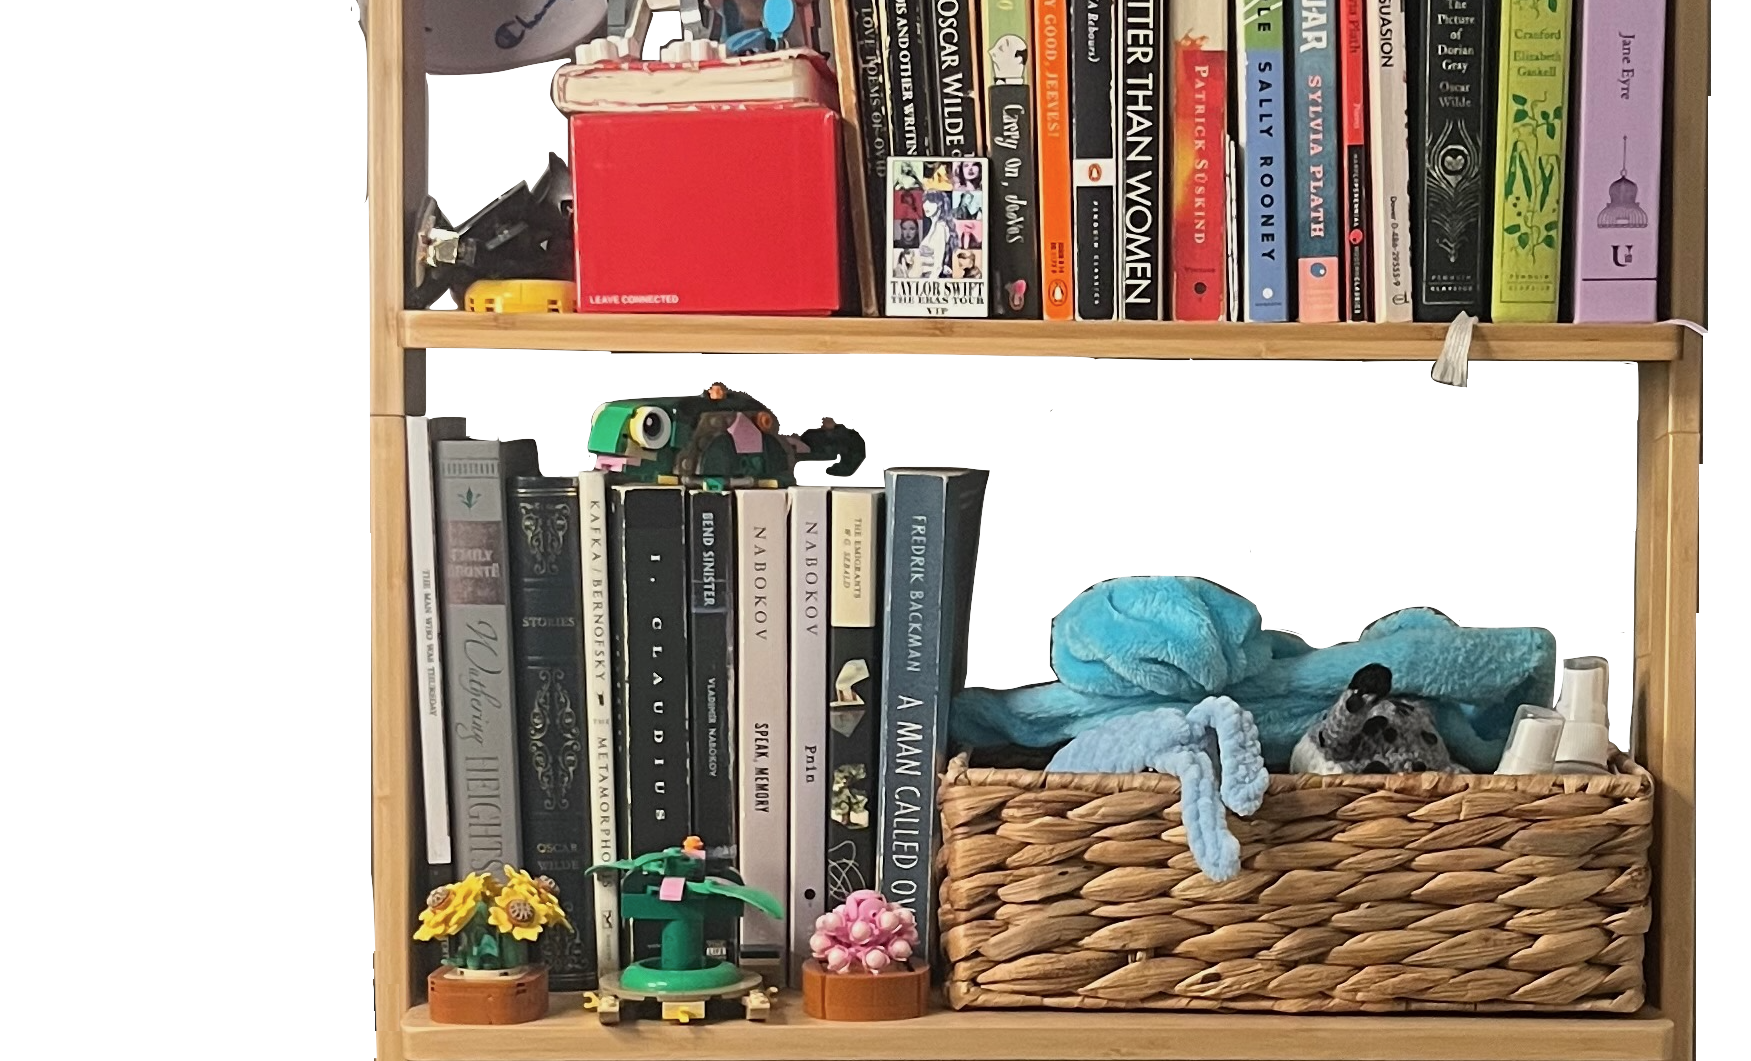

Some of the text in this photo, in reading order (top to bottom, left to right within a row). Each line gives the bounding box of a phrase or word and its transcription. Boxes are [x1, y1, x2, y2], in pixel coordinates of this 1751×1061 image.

[896, 16, 910, 49] AND
[1087, 12, 1101, 63] Rebours)
[1349, 20, 1362, 54] Plath
[1437, 13, 1475, 25] Picture
[1450, 27, 1463, 40] of
[1514, 27, 1561, 40] Cranford
[899, 49, 914, 101] OTHER
[1437, 44, 1475, 56] Dorian
[1441, 59, 1469, 74] Gray
[1619, 30, 1636, 101] Jane Eyre
[942, 73, 965, 146] WILDE
[1194, 65, 1209, 151] PATRICK
[1438, 96, 1472, 108] Wilde
[1439, 81, 1471, 93] Oscar
[903, 102, 919, 156] WRITIN
[993, 104, 1025, 150] Carry
[1126, 72, 1154, 161] THAN
[1257, 61, 1276, 262] SALLY ROONEY
[1308, 74, 1325, 238] SYLVIA PLATH
[1004, 194, 1027, 244] Jeeves
[1125, 170, 1153, 304] WOMEN
[588, 294, 680, 305] LEAVE CONNECTED
[890, 281, 985, 297] TAYLOR SWIFT
[891, 296, 985, 305] THE ERAS TOUR
[926, 307, 949, 315] VIP
[589, 500, 602, 561] KAFKA
[702, 511, 717, 607] BEND SINISTER
[753, 525, 768, 641] NABOKOV
[805, 521, 819, 636] NABOKOV
[842, 550, 851, 589] SEBALD
[853, 517, 863, 599] THE EMIGRANTS
[906, 514, 927, 673] FREDRIK BACKMAN
[422, 569, 438, 717] THE MAN WHO WAS THURSDAY
[522, 616, 576, 628] STORIES
[592, 578, 606, 681] BERNOFSKY
[651, 617, 667, 821] CLAUDIUS
[707, 677, 718, 778] VLADIMIR NABOKOV
[455, 618, 506, 875] Wuthering HEIGHTS
[753, 722, 770, 814] SPEAK, MEMORY
[804, 745, 817, 784] Pnin
[597, 736, 613, 888] METAMORPHOIS
[889, 694, 925, 915] A MAN CALLED OV
[536, 842, 578, 854] OSCAR
[537, 859, 580, 871] WILDE
